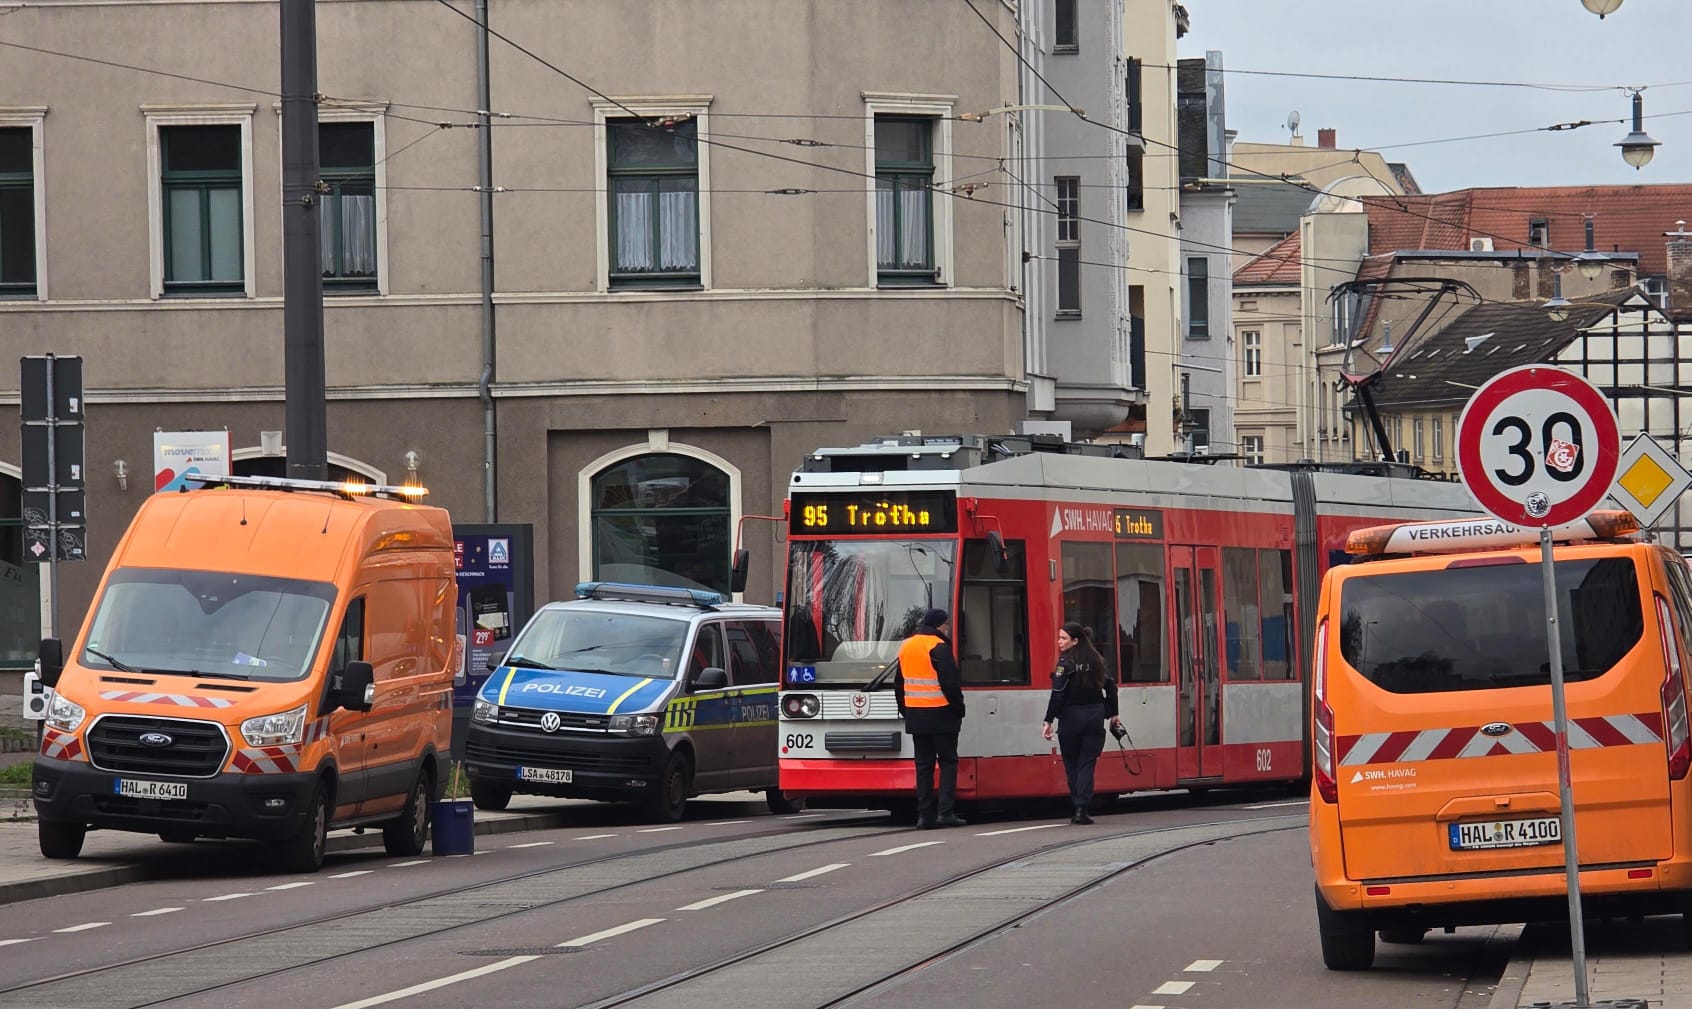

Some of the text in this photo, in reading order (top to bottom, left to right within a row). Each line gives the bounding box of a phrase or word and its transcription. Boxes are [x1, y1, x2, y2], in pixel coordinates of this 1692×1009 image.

[1492, 412, 1584, 486] 30
[804, 505, 828, 526] 95
[1064, 509, 1113, 532] SWH. HAVAG
[1115, 515, 1152, 534] 6 Trotha
[1409, 523, 1521, 540] VERKEHRSAU
[522, 683, 607, 699] POLIZEI
[741, 704, 770, 721] POLIZEI
[786, 734, 813, 748] 602
[1257, 748, 1271, 772] 602
[522, 768, 571, 781] LSA 48178
[1365, 768, 1416, 780] SWH. HAVAG
[121, 781, 141, 794] HAL
[149, 784, 158, 795] R
[158, 785, 186, 797] 6410
[1461, 821, 1558, 844] HAL R 4100
